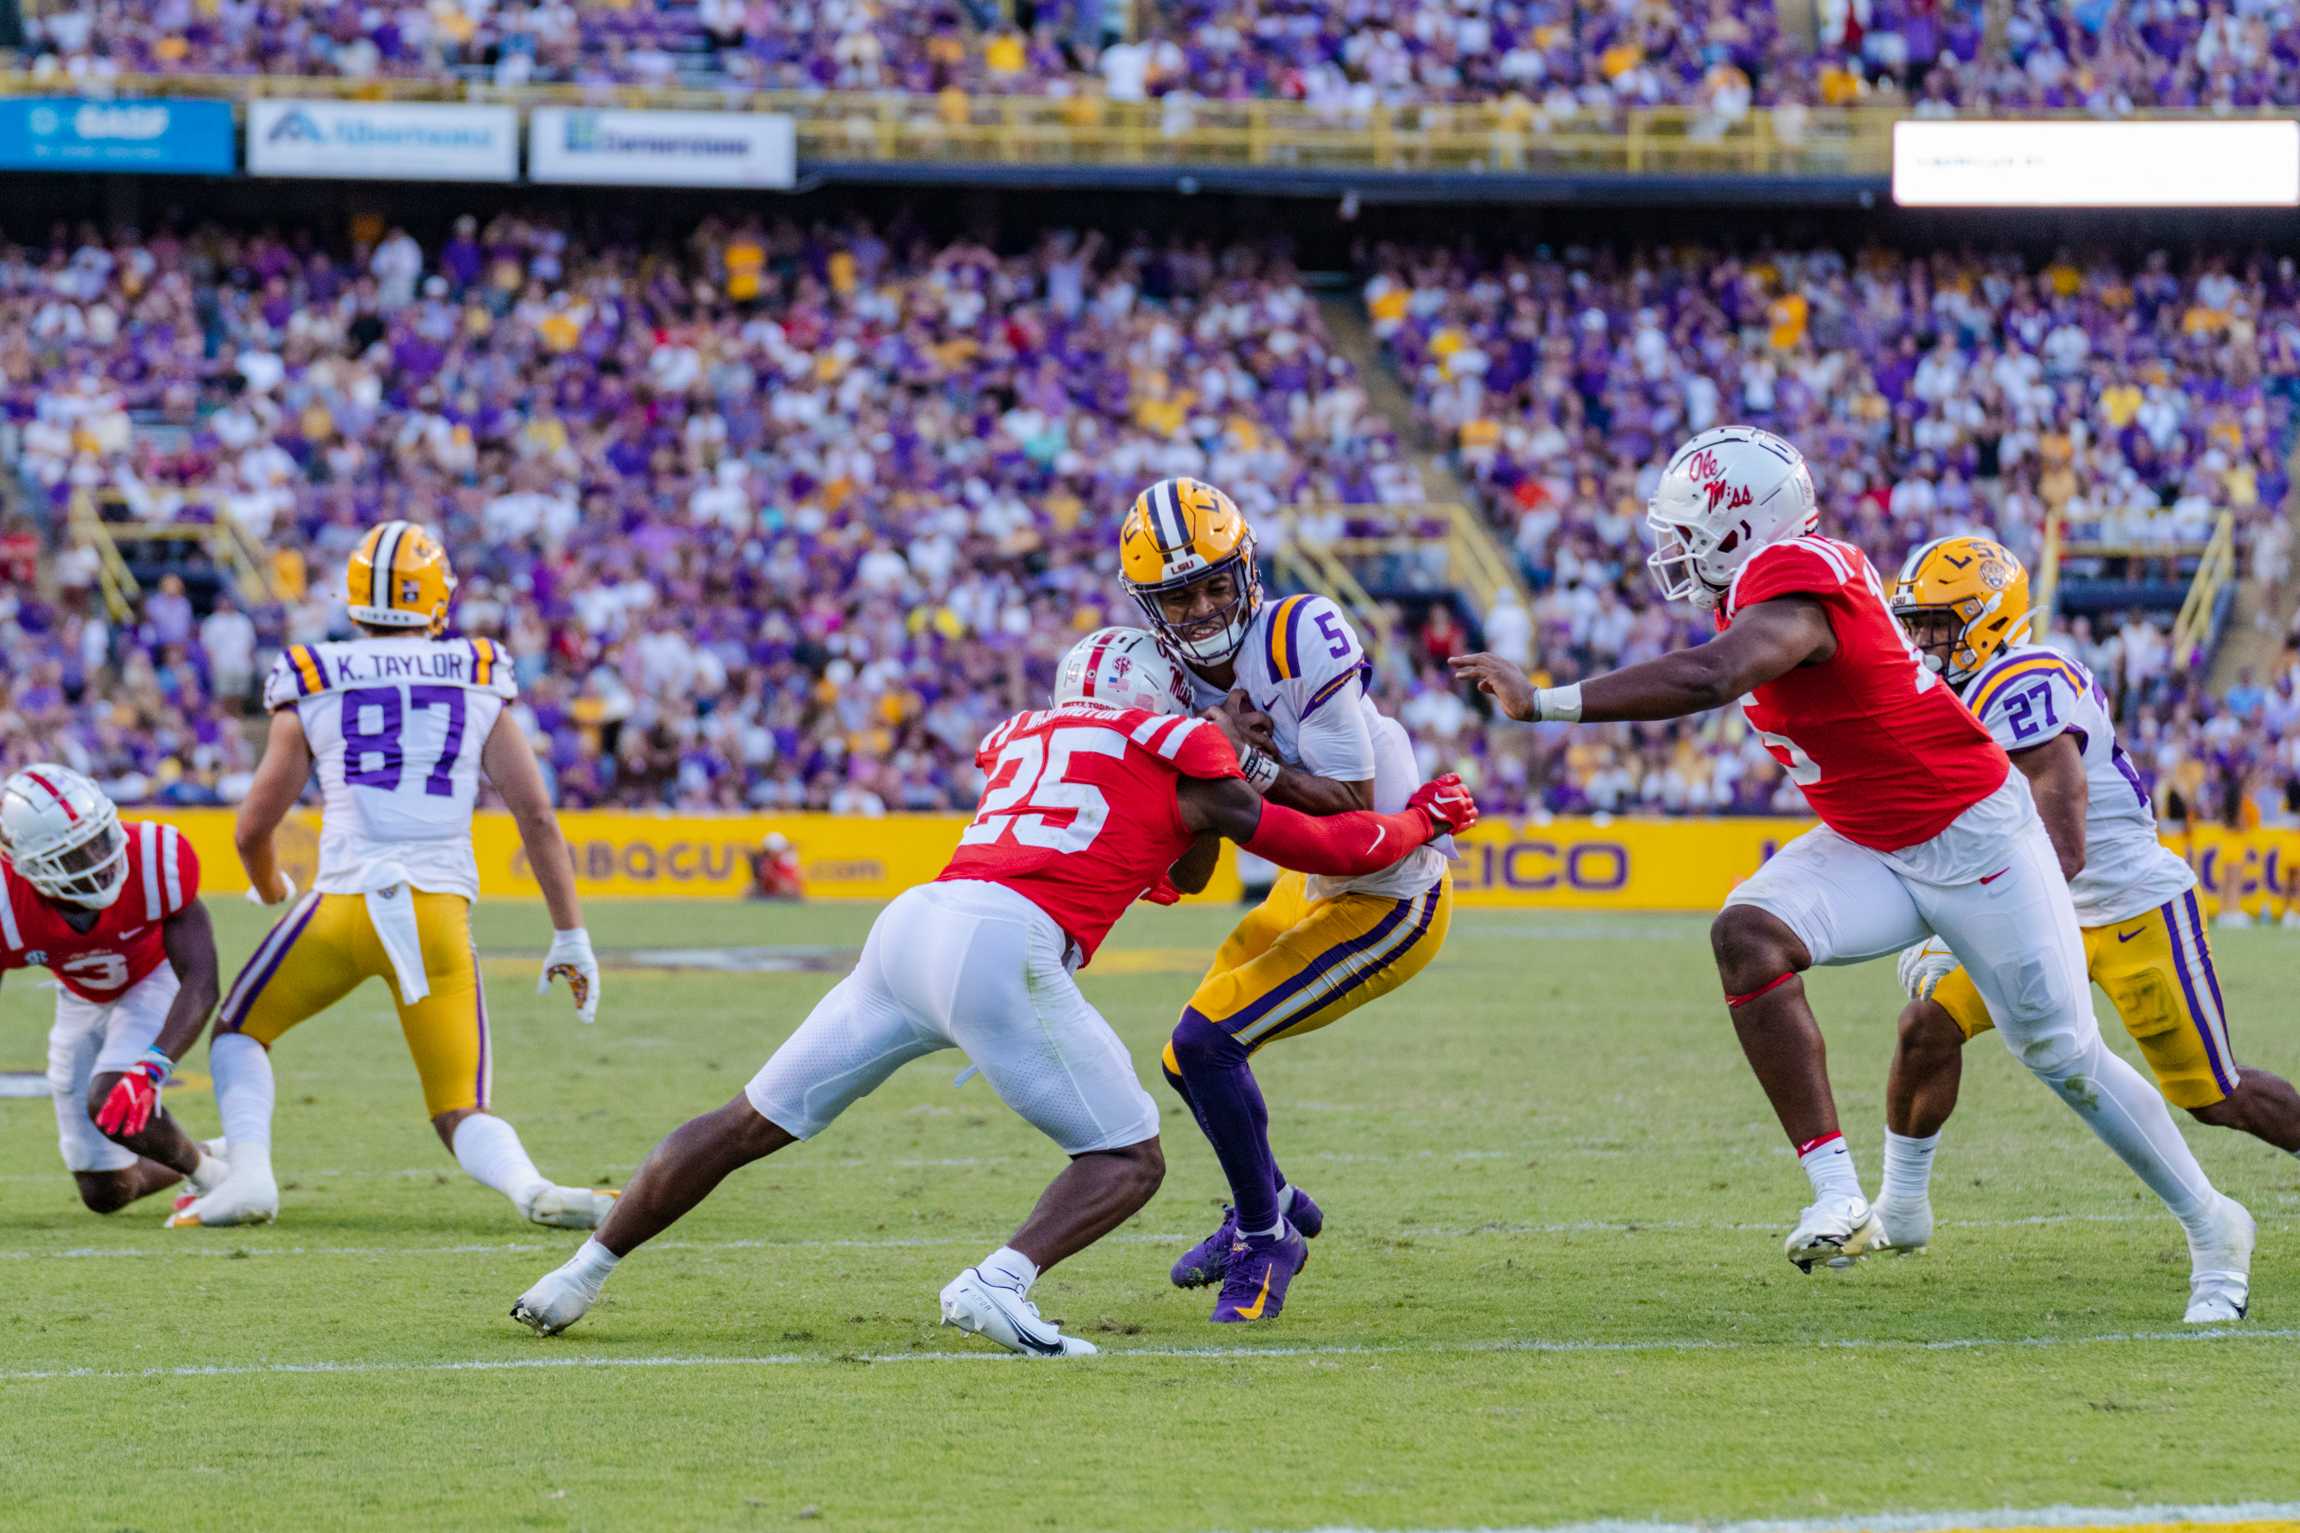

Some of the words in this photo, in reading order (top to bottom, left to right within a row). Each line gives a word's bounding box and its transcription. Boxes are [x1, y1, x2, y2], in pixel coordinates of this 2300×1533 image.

[1689, 448, 1719, 483] Ole
[1703, 478, 1754, 515] Miss
[1170, 559, 1195, 575] LSU
[1313, 610, 1351, 660] 5
[337, 655, 364, 682] K.
[372, 653, 464, 681] TAYLOR
[2003, 680, 2059, 742] 27
[341, 684, 466, 797] 87
[956, 726, 1129, 855] 25
[62, 952, 128, 991] 3
